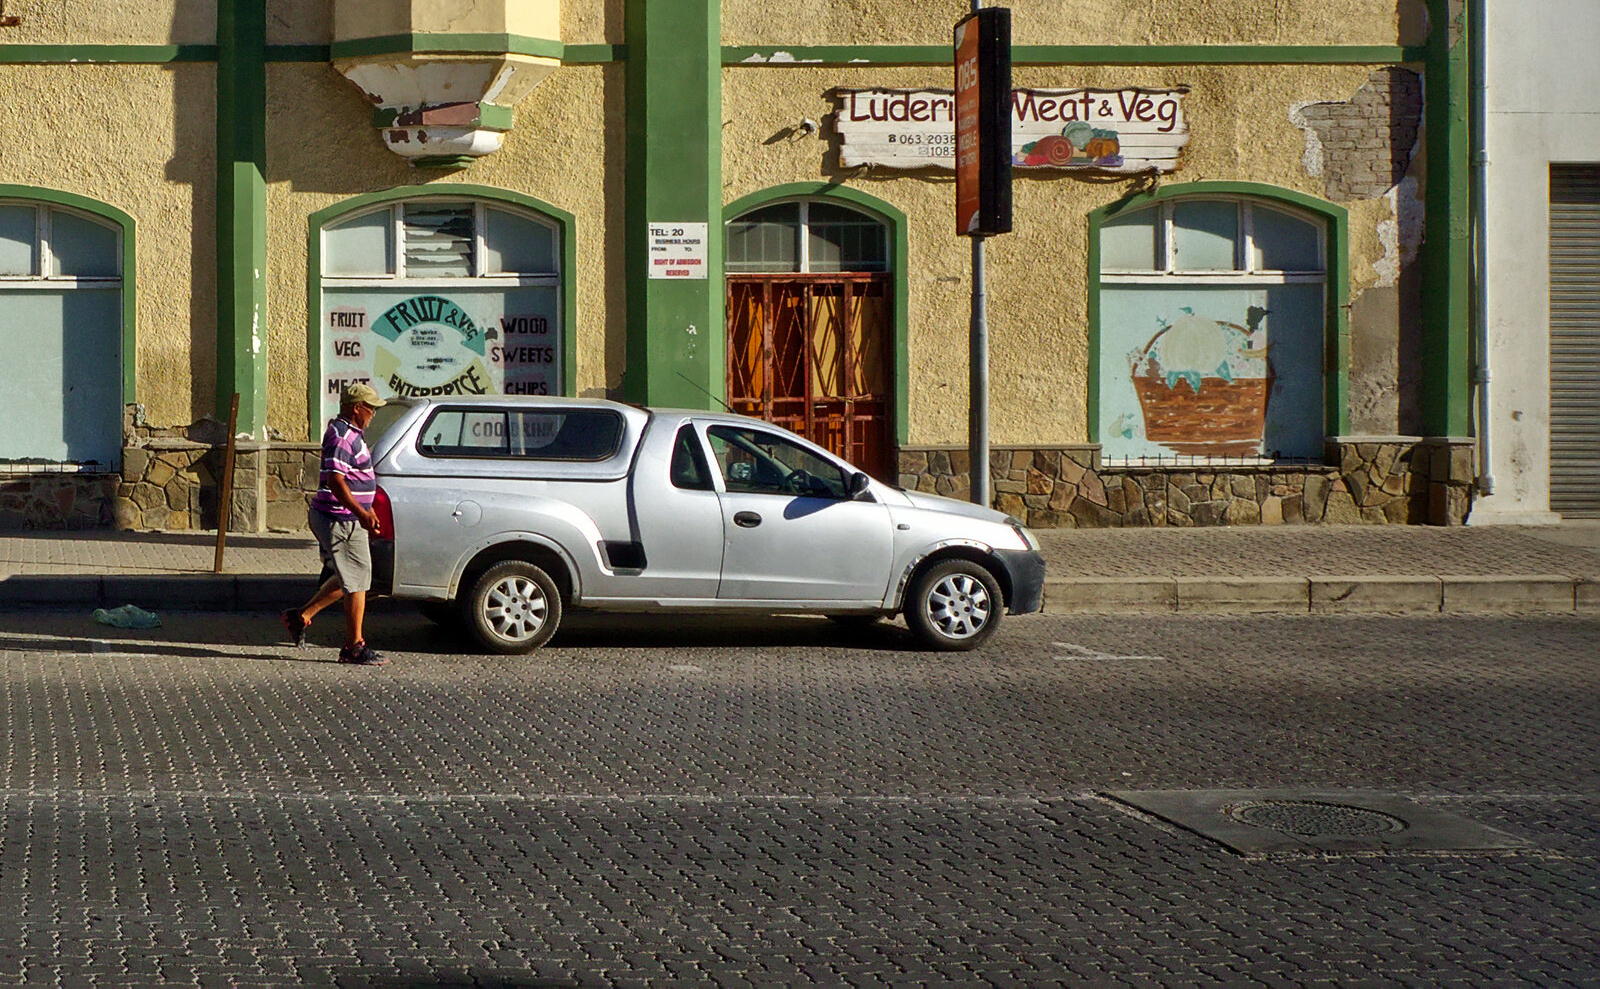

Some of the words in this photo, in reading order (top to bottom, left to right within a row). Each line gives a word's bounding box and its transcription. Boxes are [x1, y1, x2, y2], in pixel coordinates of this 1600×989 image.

[958, 57, 976, 92] 085
[850, 90, 954, 122] Lüderi
[1011, 91, 1095, 122] Meat
[1098, 100, 1113, 117] &
[1117, 90, 1178, 132] Veg
[900, 135, 921, 144] 063
[928, 135, 955, 144] 2038
[330, 312, 365, 328] FRUIT
[384, 296, 449, 333] FRUIT
[444, 308, 458, 327] &
[500, 317, 548, 334] WOOD
[334, 341, 361, 357] VEG
[491, 347, 553, 363] SWEETS
[505, 381, 548, 395] CHIPS
[472, 422, 505, 437] COO
